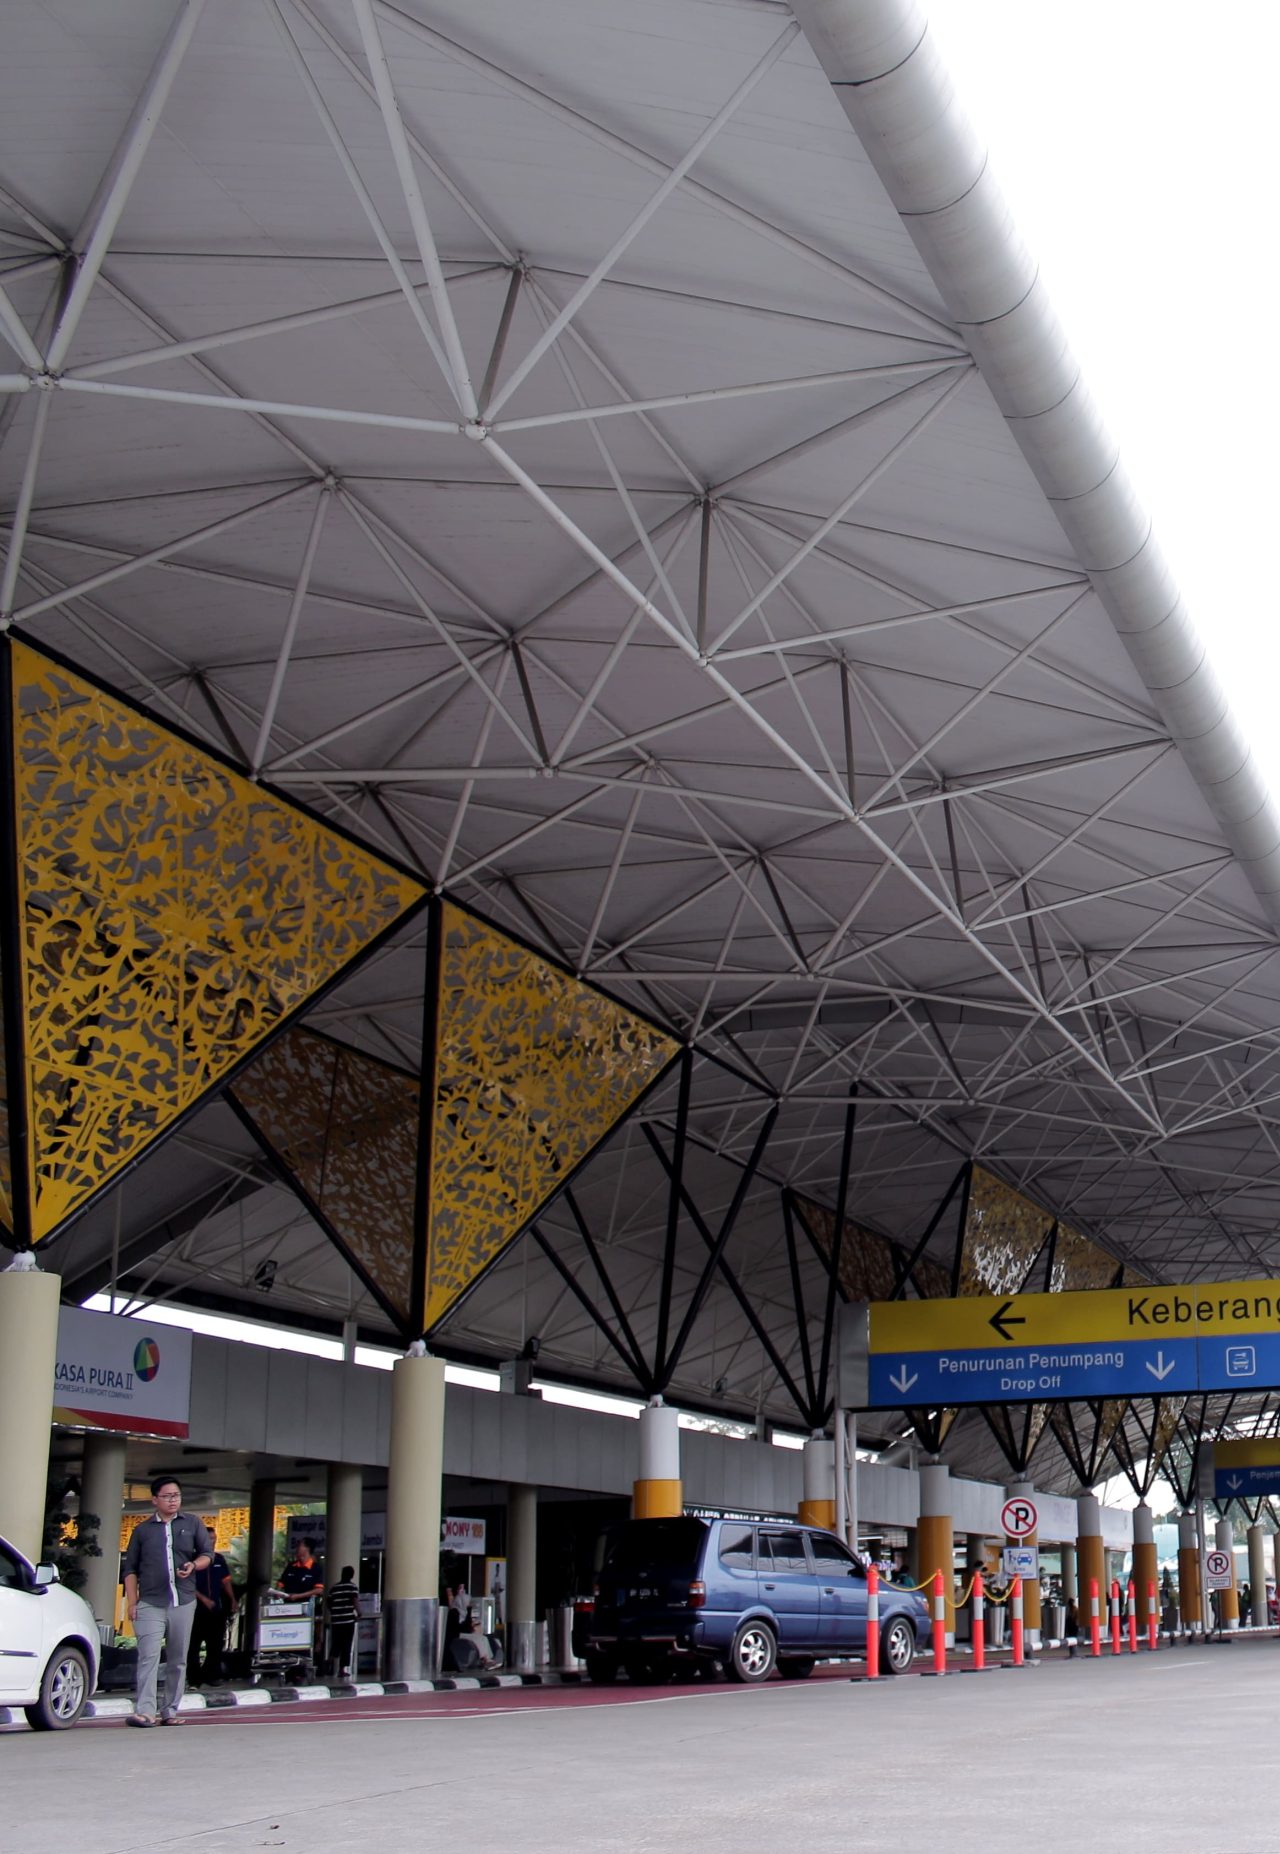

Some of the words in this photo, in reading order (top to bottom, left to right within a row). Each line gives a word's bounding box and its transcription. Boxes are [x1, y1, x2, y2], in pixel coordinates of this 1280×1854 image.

[939, 1357, 1025, 1374] Penurunan
[1029, 1352, 1125, 1370] Penumpang
[89, 1367, 124, 1389] PURA
[1001, 1378, 1036, 1392] Drop
[1039, 1376, 1062, 1389] Off
[1015, 1507, 1029, 1530] P
